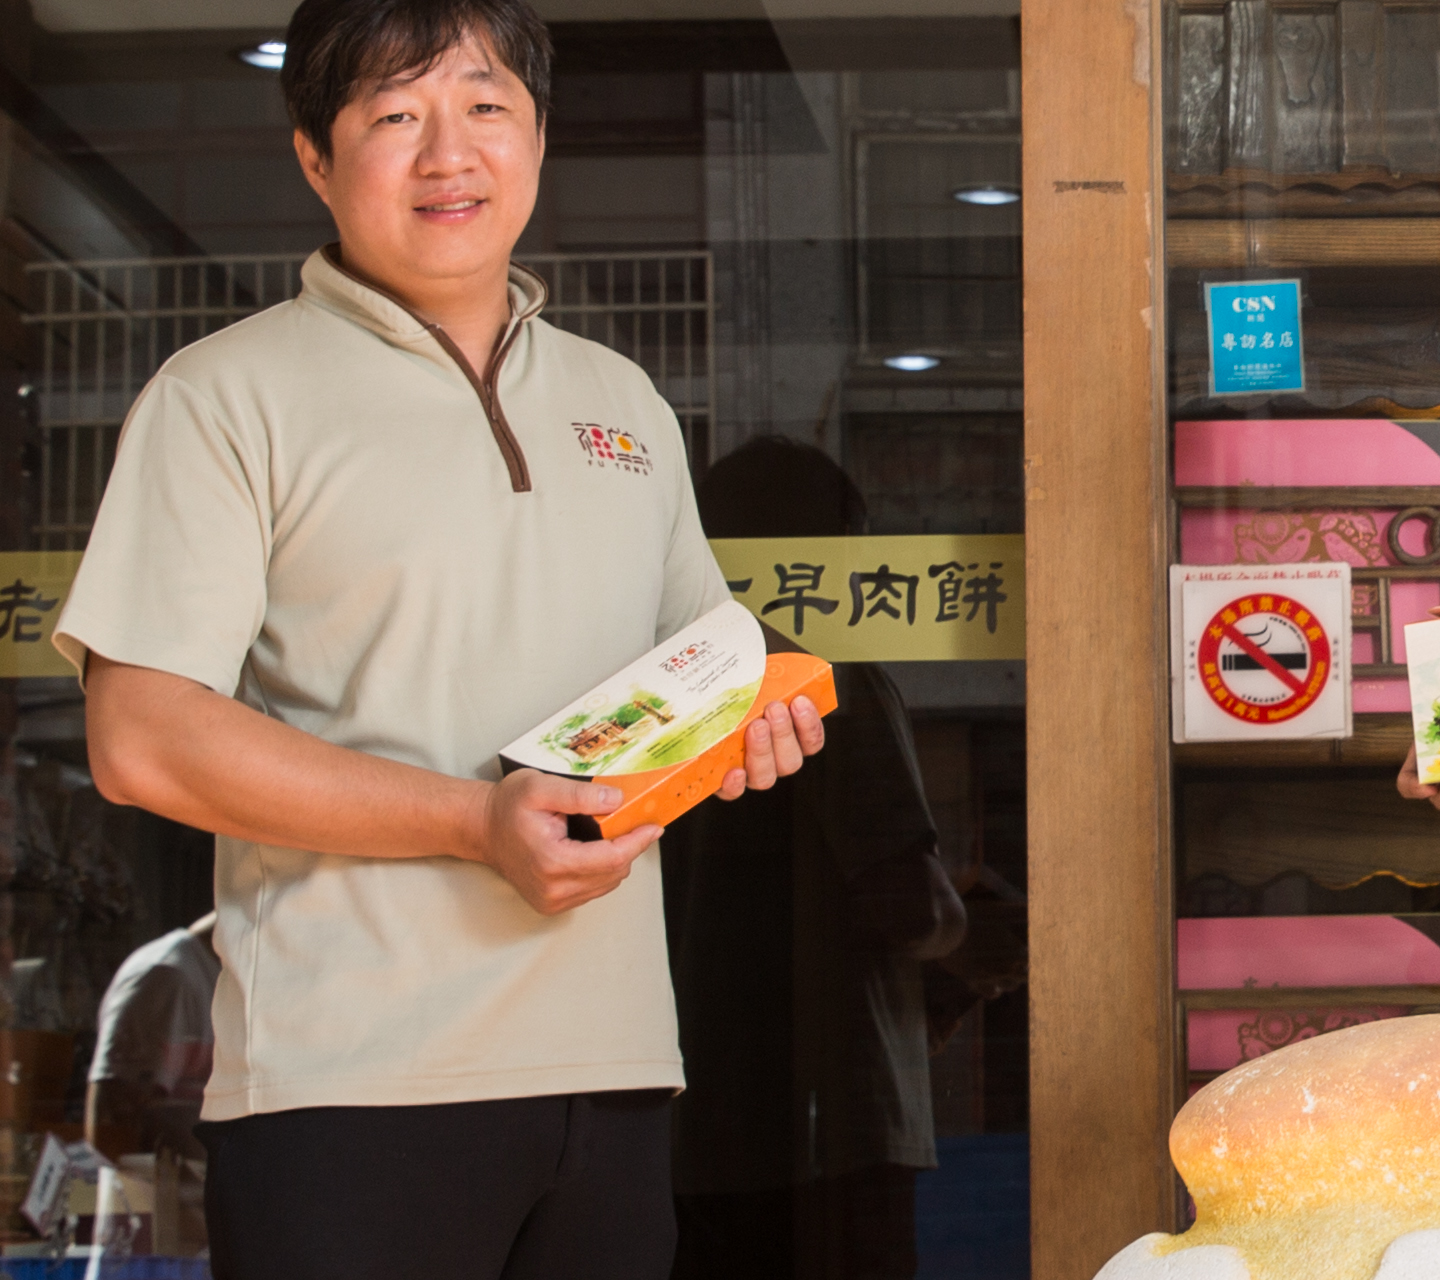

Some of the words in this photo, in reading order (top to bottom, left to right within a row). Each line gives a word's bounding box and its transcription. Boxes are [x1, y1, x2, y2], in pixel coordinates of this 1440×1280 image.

[1232, 295, 1276, 313] CSN
[1221, 331, 1293, 351] 專訪名店
[727, 561, 1008, 635] 早肉餅
